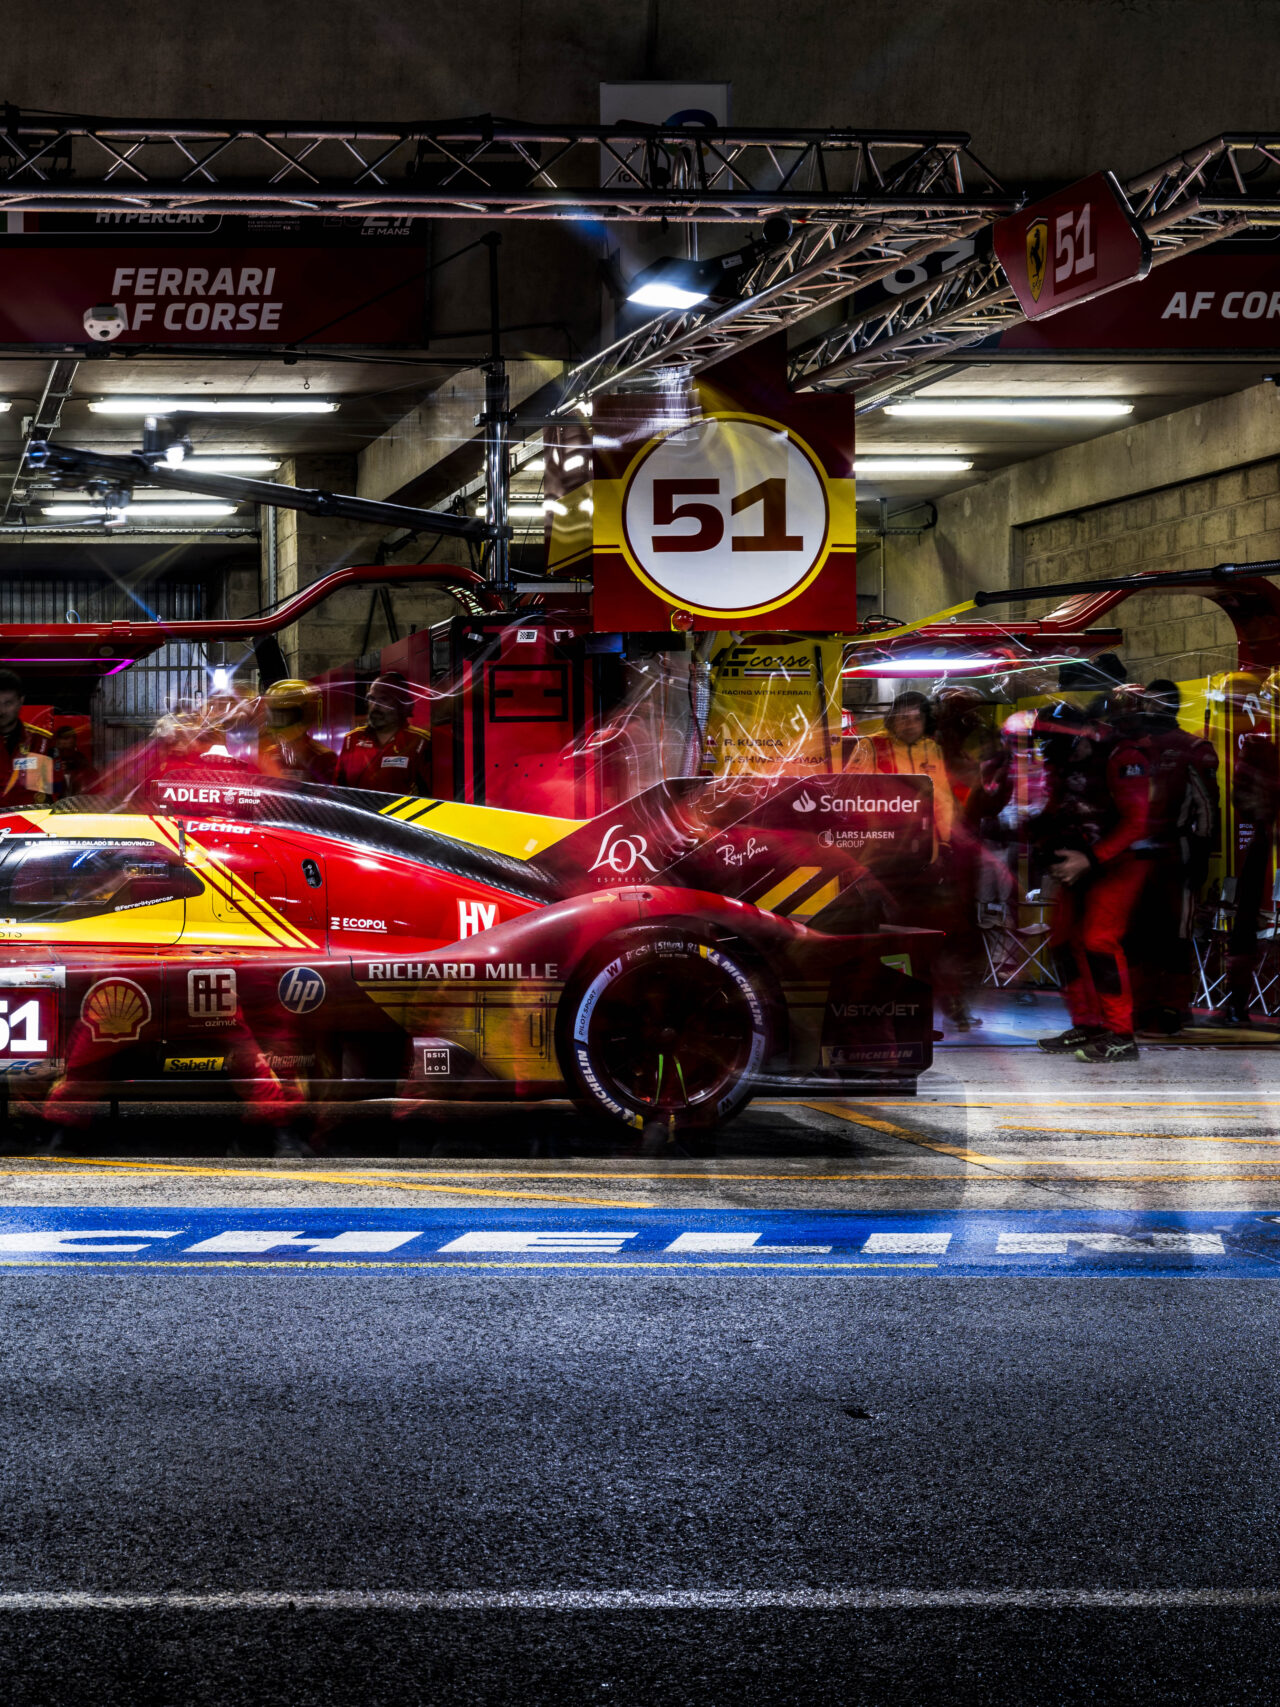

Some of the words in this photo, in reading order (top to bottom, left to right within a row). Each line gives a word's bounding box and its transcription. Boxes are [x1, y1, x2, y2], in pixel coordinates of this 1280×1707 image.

[1055, 202, 1096, 283] 51
[111, 267, 276, 296] FERRARI
[1160, 292, 1216, 319] AF
[163, 303, 283, 330] CORSE
[651, 477, 804, 553] 51
[750, 656, 810, 667] corse
[163, 788, 220, 803] ADLER
[820, 795, 920, 813] Santander
[836, 831, 858, 839] LARS
[861, 831, 894, 839] LARSEN
[836, 840, 864, 849] GROUP
[343, 918, 387, 929] ECOPOL
[368, 963, 475, 979] RICHARD
[485, 963, 559, 979] MILLE
[605, 962, 620, 978] W
[284, 968, 321, 1013] hp
[721, 960, 764, 1026] MICHELIN
[582, 990, 598, 1013] SPORT
[205, 1018, 237, 1028] azimut
[578, 1010, 589, 1036] PILOT
[848, 1049, 913, 1061] MICHELIN
[170, 1058, 219, 1071] Sabelt
[576, 1049, 622, 1114] MICHELIN
